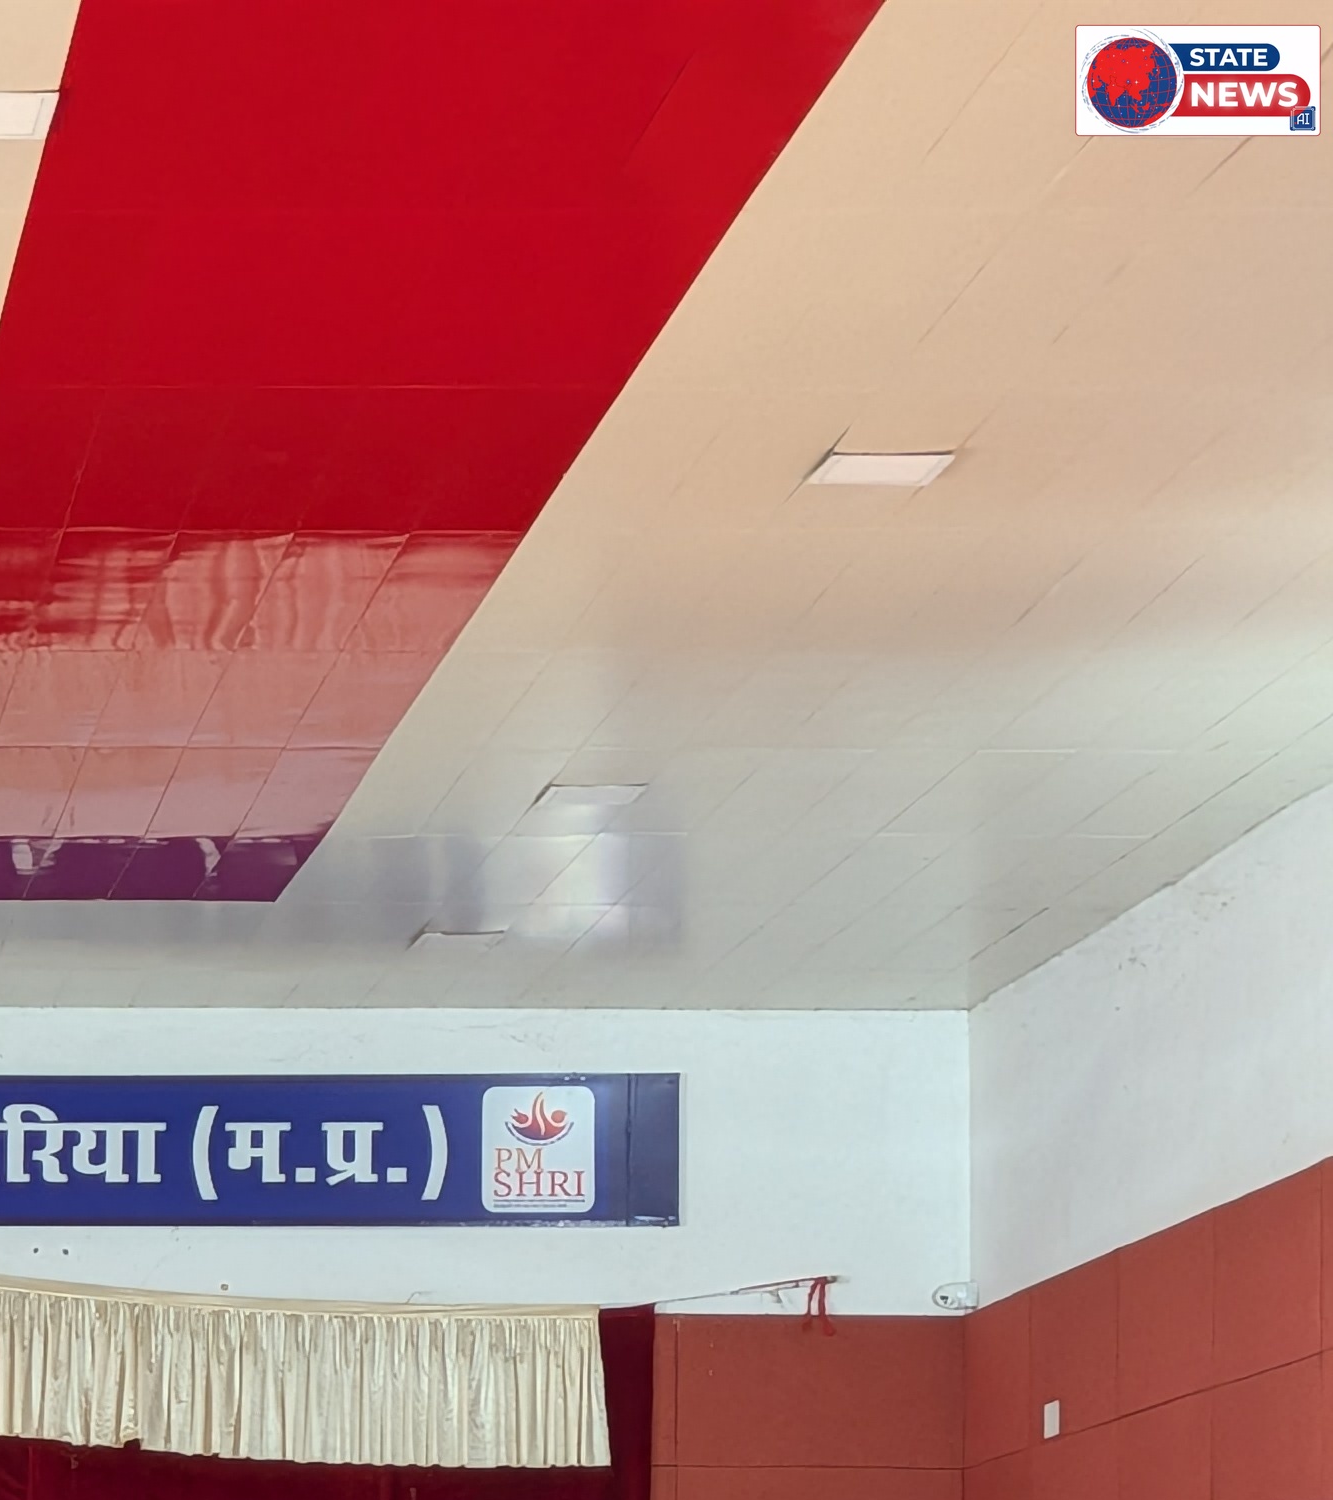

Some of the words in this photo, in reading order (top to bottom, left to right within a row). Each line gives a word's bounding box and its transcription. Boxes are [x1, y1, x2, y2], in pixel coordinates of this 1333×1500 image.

[192, 1104, 448, 1201] (म.प्र.)
[494, 1147, 543, 1174] PM
[493, 1169, 586, 1198] SHRI
